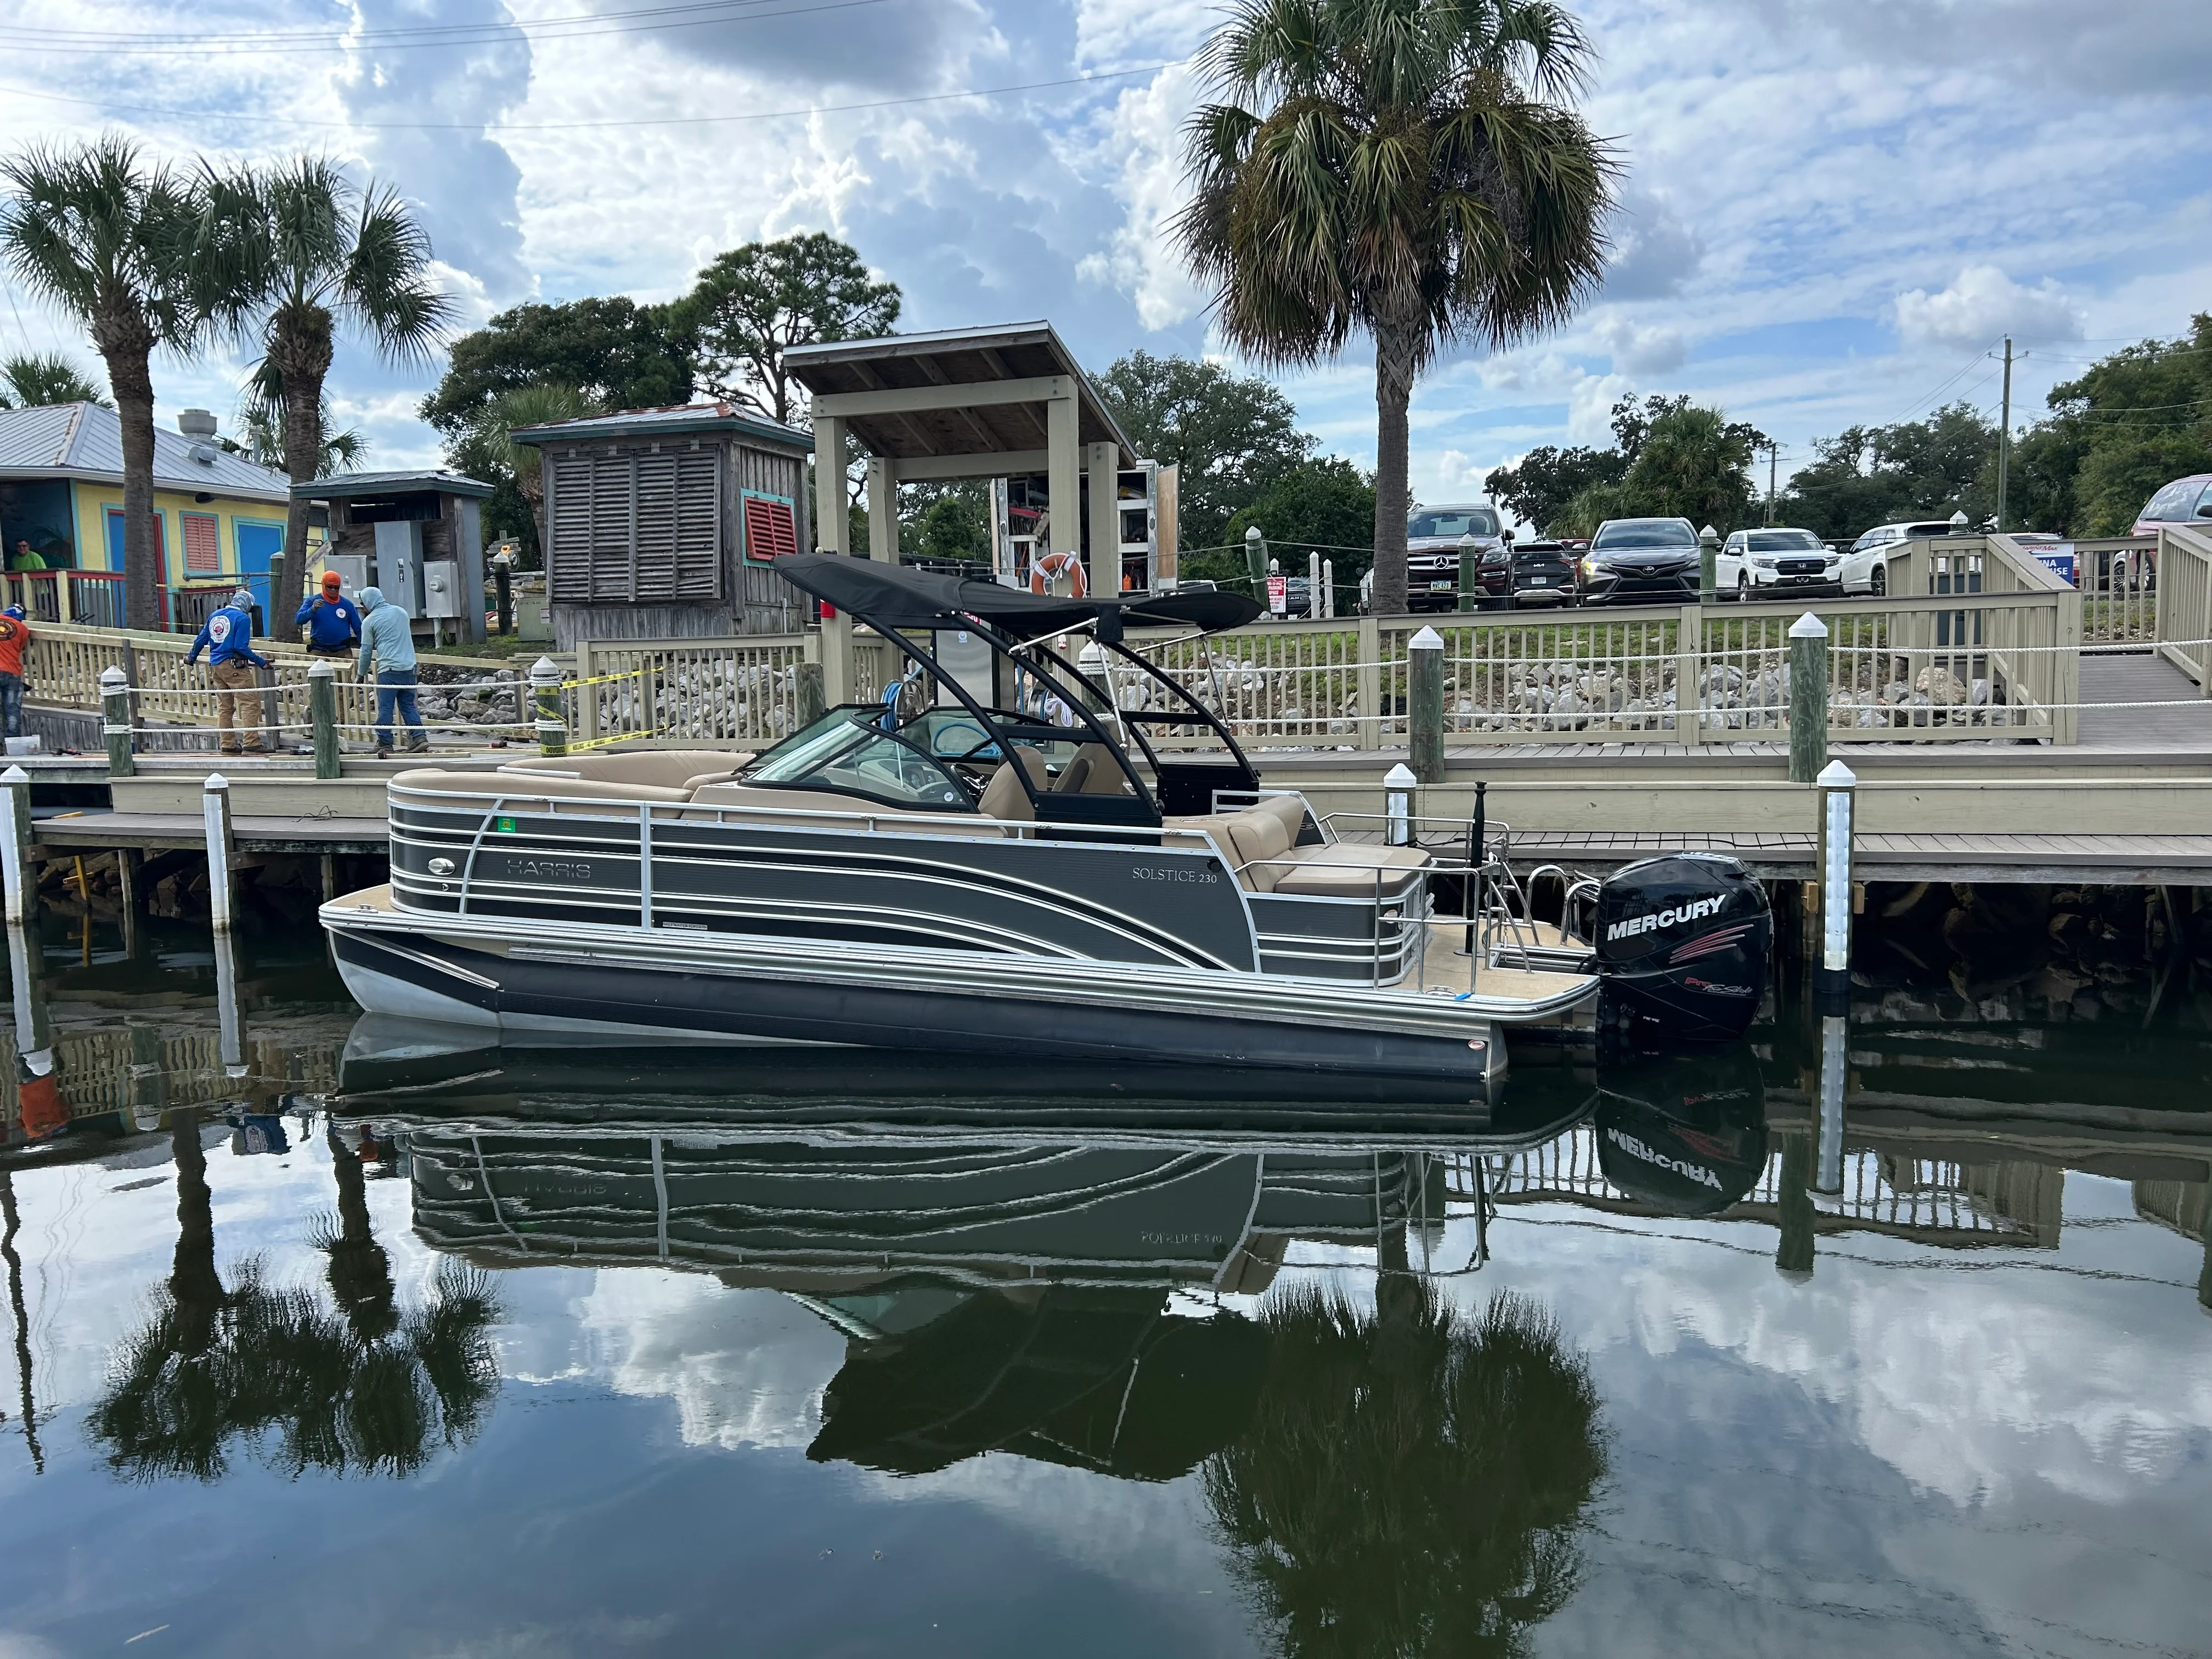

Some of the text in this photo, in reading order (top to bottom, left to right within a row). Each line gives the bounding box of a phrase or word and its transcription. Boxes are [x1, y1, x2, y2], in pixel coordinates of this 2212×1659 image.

[507, 860, 591, 878] HARRIS
[1132, 867, 1217, 883] SOLSTICE 230
[1607, 894, 1726, 941] MERCURY
